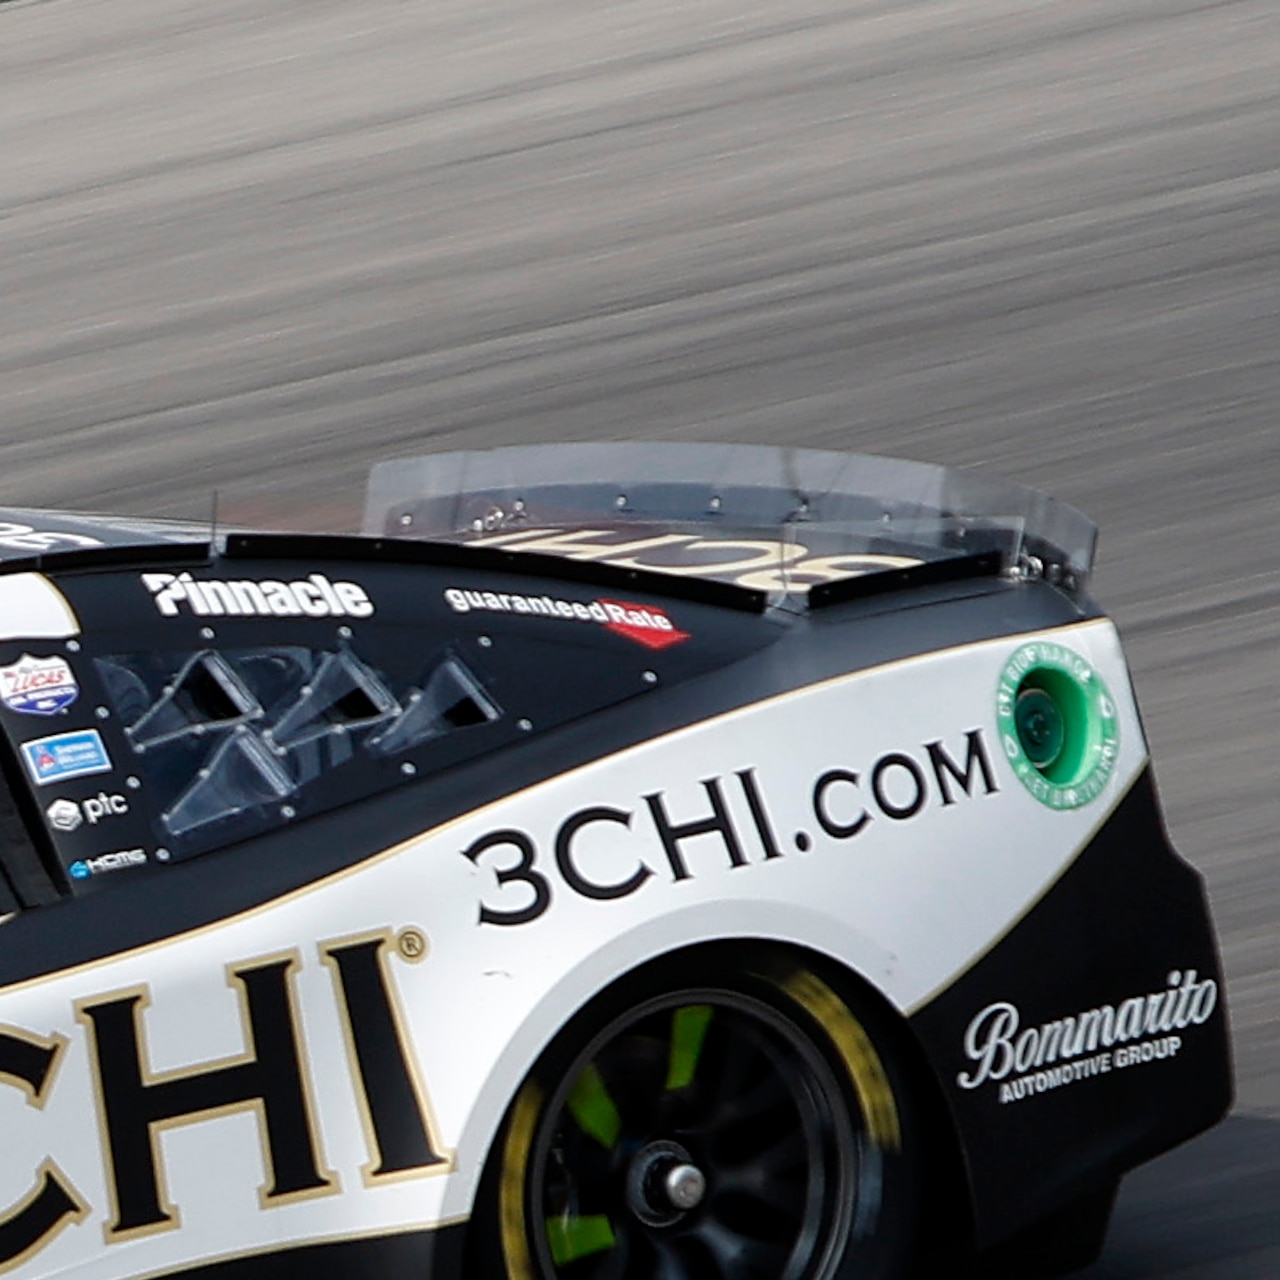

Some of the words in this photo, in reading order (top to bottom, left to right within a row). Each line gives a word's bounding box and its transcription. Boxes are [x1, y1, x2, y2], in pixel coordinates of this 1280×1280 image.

[141, 573, 374, 618] Pinnacle
[82, 792, 129, 824] ptc
[460, 729, 1001, 926] 3CHI.COM
[956, 969, 1217, 1089] Bommarito
[1000, 1053, 1112, 1103] AUTOMOTIVE
[1113, 1036, 1182, 1068] GROUP
